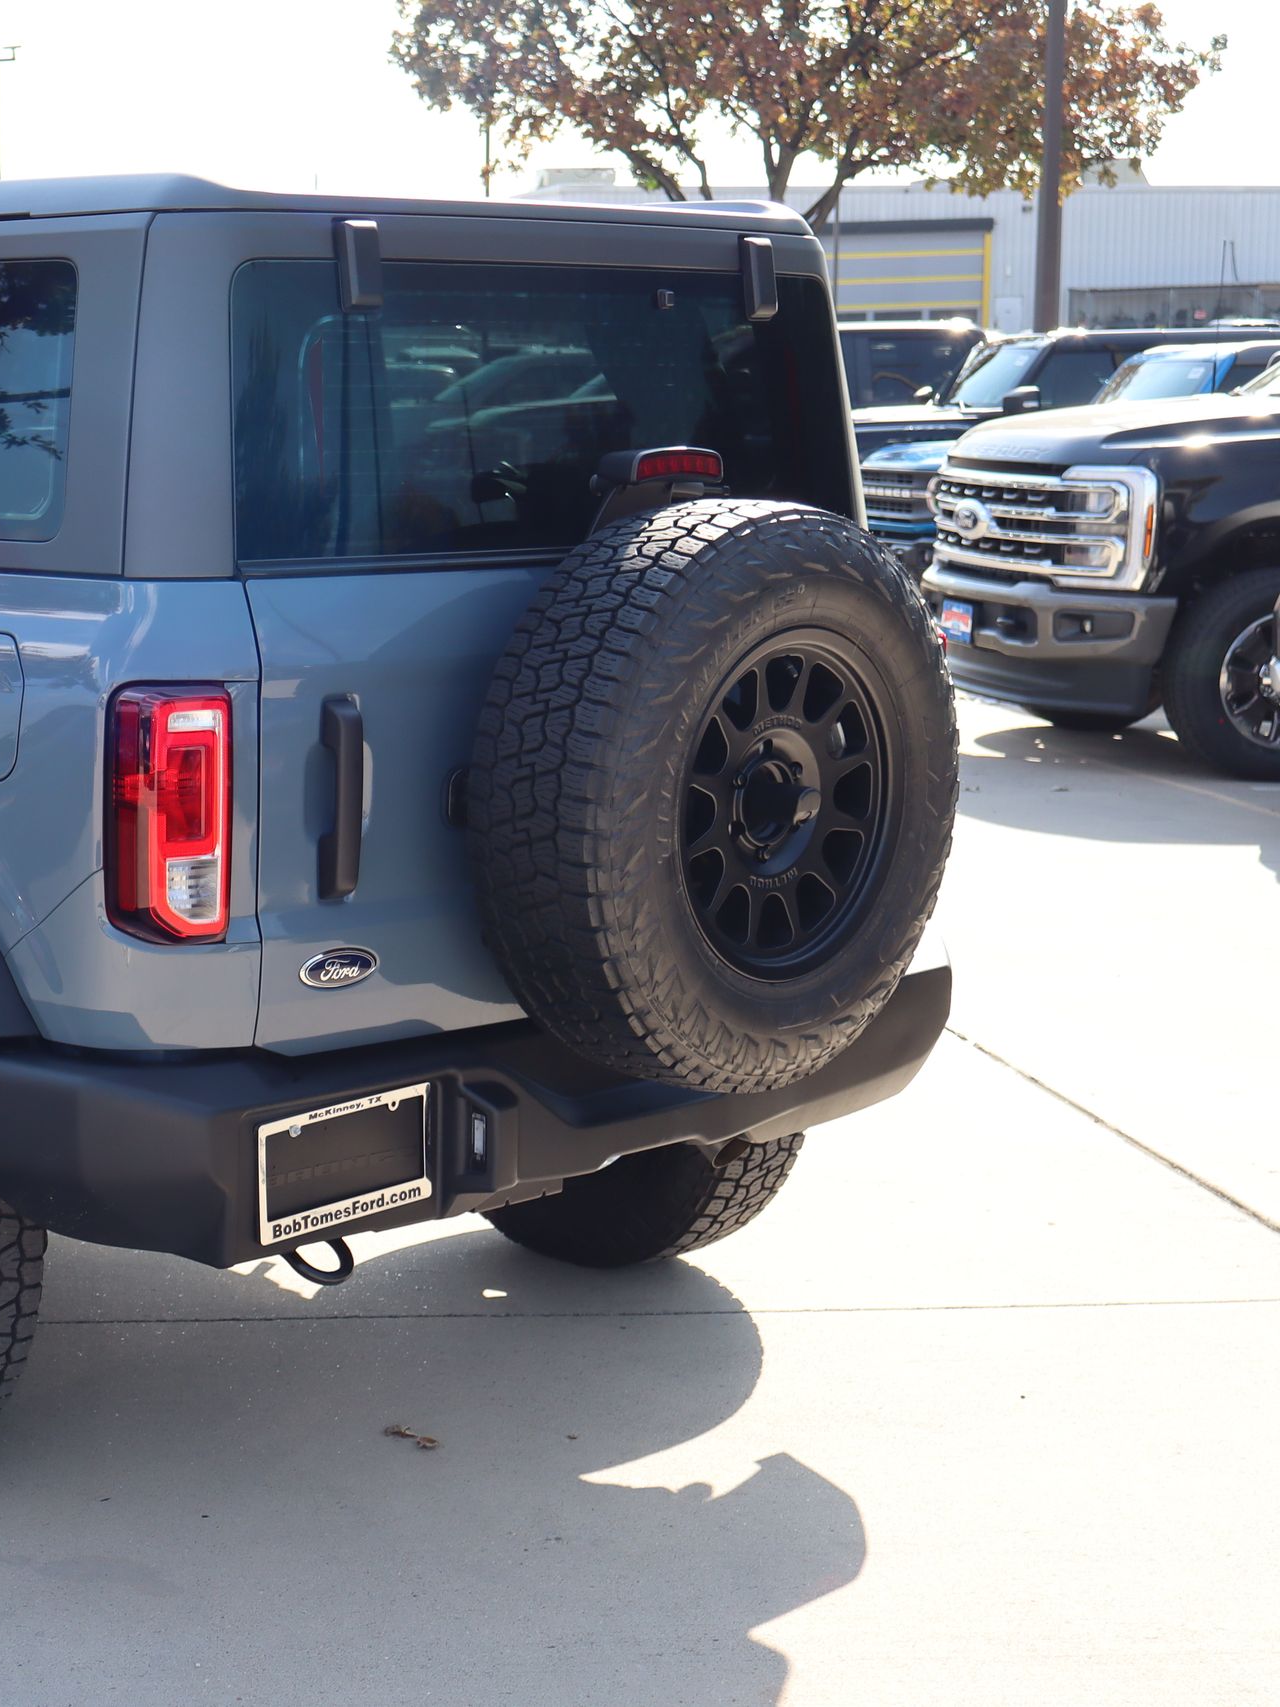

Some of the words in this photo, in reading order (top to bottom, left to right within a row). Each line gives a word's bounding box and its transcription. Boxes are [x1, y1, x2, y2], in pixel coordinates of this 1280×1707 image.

[752, 716, 802, 736] METHOD
[319, 959, 361, 982] Ford
[308, 1103, 365, 1121] McKinney,
[368, 1096, 383, 1104] TX
[272, 1185, 422, 1240] BobTomesFord.com
